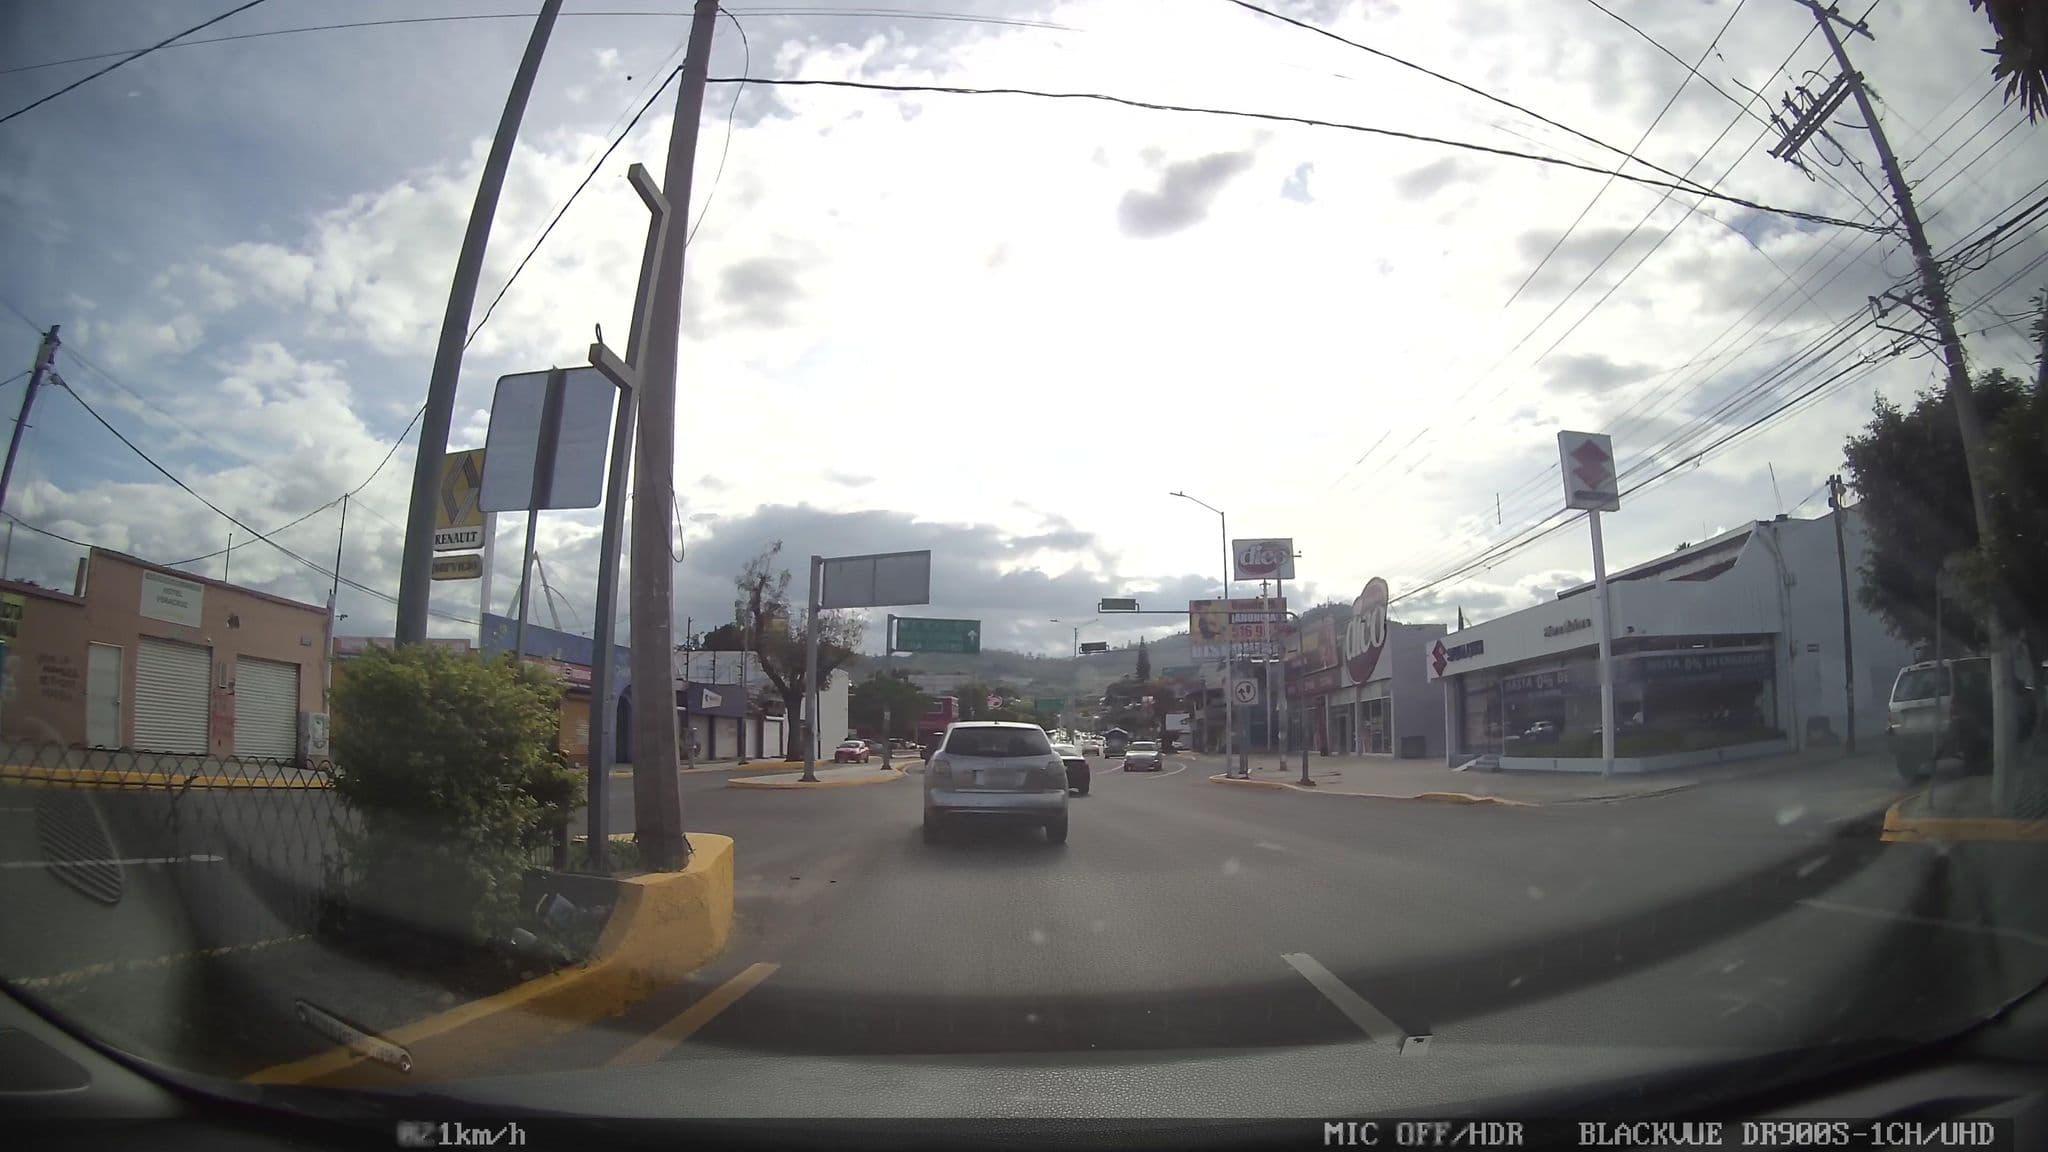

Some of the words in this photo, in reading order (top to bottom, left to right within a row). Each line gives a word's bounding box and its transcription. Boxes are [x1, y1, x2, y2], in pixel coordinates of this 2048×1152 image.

[435, 531, 478, 545] RENAULT
[1239, 545, 1288, 566] dico
[1346, 606, 1386, 661] dico
